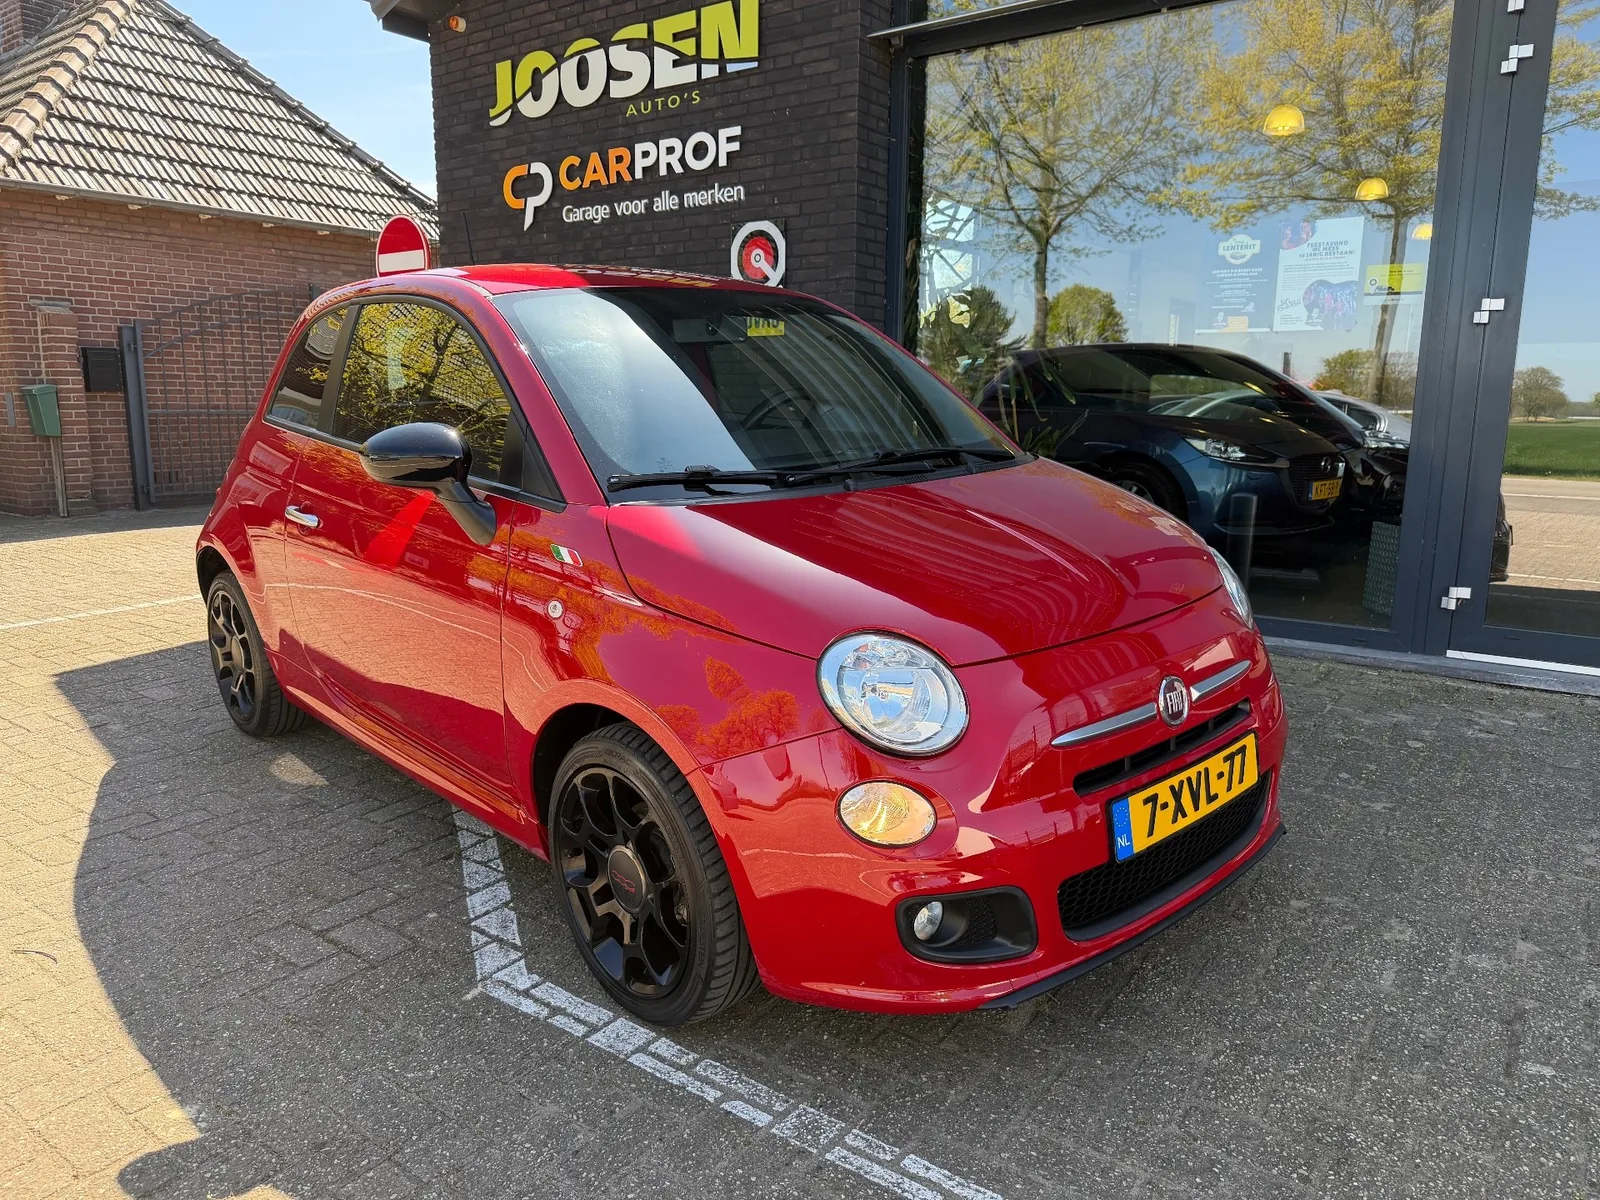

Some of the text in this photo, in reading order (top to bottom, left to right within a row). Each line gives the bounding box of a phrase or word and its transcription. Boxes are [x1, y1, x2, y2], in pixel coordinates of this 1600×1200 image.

[489, 0, 759, 126] JOOSEN
[625, 90, 701, 117] AUTO'S
[559, 126, 742, 190] CARPROF
[562, 183, 745, 223] Garage voor alle merken
[1166, 689, 1184, 714] FIAT
[1143, 744, 1248, 838] 7-XVL-77
[1117, 833, 1131, 849] NL
